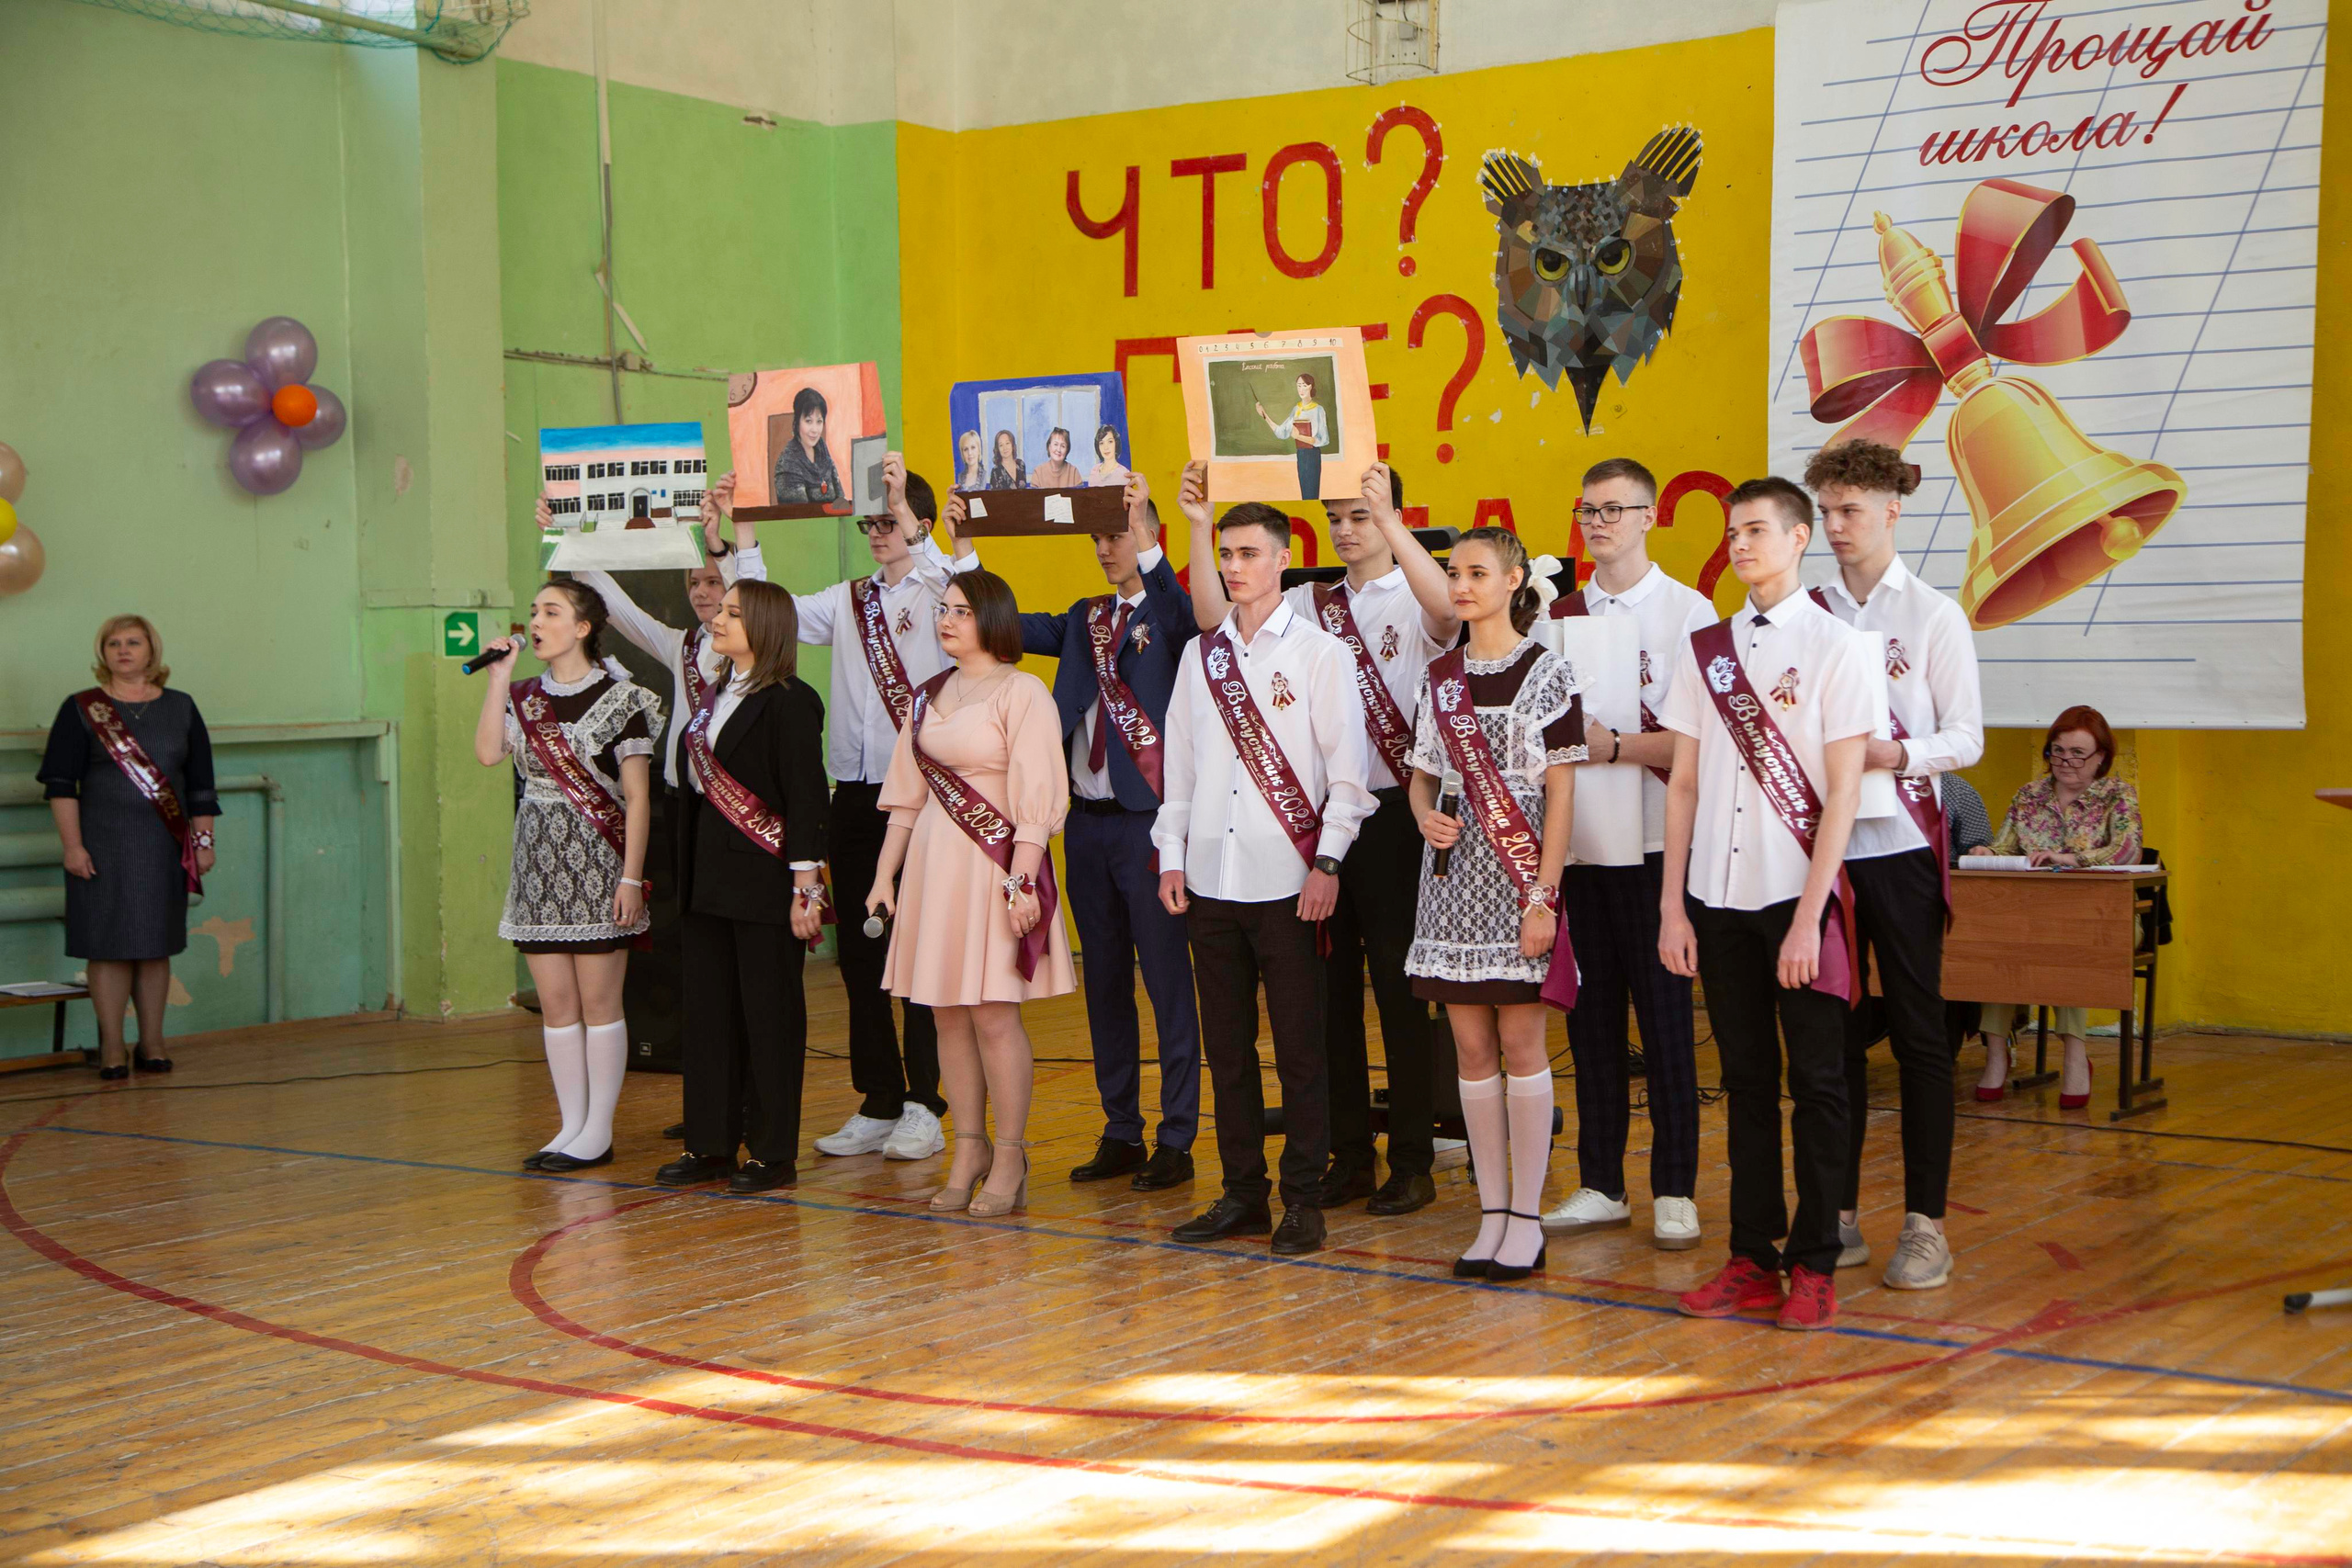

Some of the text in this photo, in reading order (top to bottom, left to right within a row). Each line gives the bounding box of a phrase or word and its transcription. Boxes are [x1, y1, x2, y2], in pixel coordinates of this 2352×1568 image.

[1921, 0, 2276, 107] Прощай
[1919, 84, 2188, 166] школа!
[1067, 106, 1442, 297] ЧТО?
[1329, 338, 1337, 346] 10
[863, 601, 897, 685] Выпускник
[1090, 625, 1157, 750] Выпускник 2022
[1340, 635, 1395, 735] Впускник
[536, 721, 602, 806] Выпускница
[693, 730, 749, 815] Выпускница
[1221, 680, 1317, 833] Выпускник 2022
[1449, 714, 1511, 829] Выпускница
[1727, 693, 1810, 813] Выпускник
[1899, 775, 1933, 803] 22
[961, 802, 1011, 845] 2022
